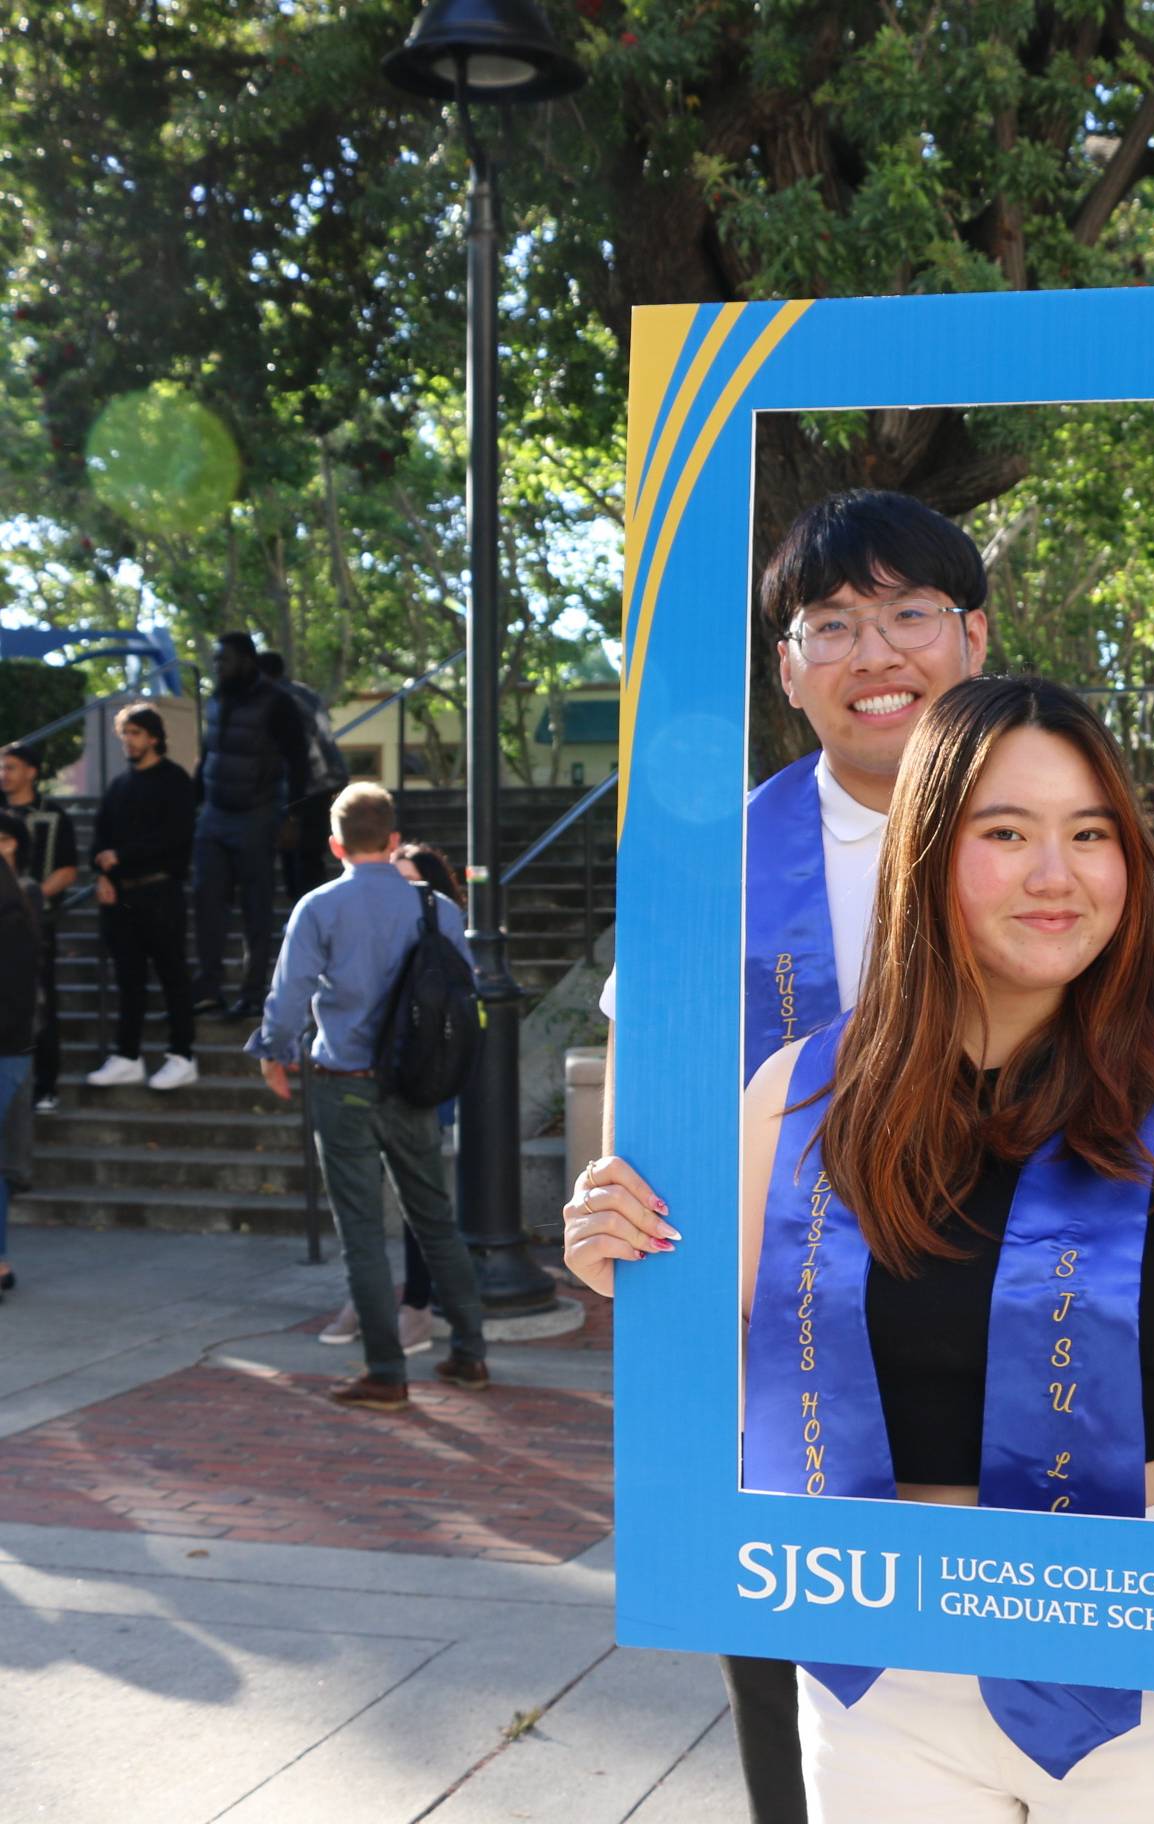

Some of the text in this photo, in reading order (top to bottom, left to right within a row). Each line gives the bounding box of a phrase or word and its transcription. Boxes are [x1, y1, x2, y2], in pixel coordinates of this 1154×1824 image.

[775, 953, 798, 1046] BUSI
[797, 1170, 833, 1496] BUSINESS HONO
[1049, 1250, 1078, 1413] SJSU
[736, 1541, 901, 1612] SJSU
[940, 1556, 1036, 1587] LUCAS
[940, 1591, 1099, 1628] GRADUATE
